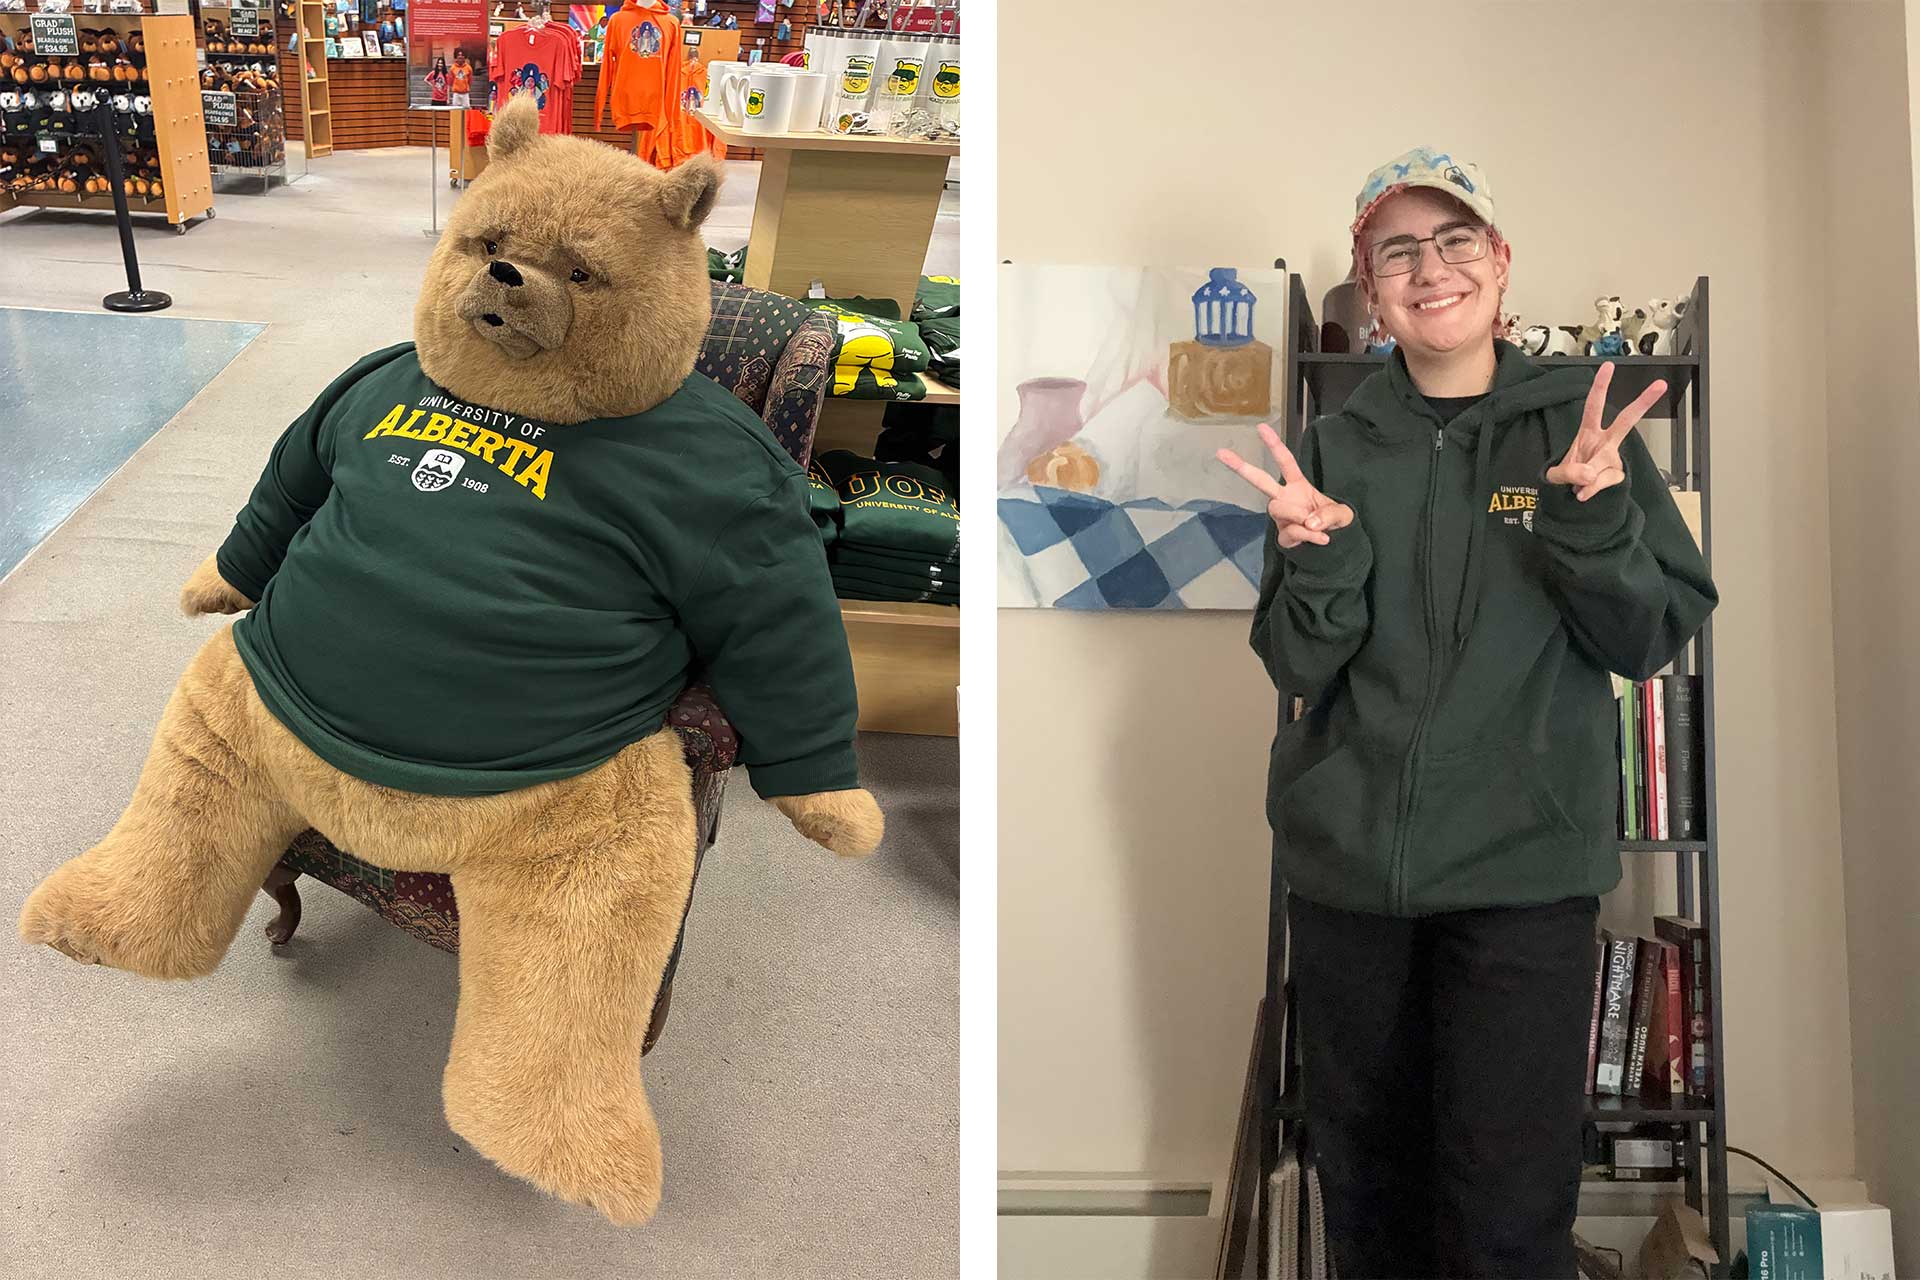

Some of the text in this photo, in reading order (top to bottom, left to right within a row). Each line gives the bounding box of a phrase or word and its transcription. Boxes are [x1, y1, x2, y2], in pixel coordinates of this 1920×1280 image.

[34, 19, 58, 28] GRAD
[47, 27, 74, 36] PLUSH
[44, 44, 69, 53] $34.95
[418, 395, 546, 440] UNIVERSITY OF
[362, 403, 555, 501] ALBERTA
[387, 453, 489, 494] EST. 1908
[1488, 492, 1539, 513] ALBE
[1500, 485, 1538, 495] UNIVERSI
[856, 501, 960, 521] UNIVERSITY OF ALB
[1624, 942, 1634, 980] FORGING A
[1607, 940, 1627, 1020] NIGHTMARE
[1633, 1026, 1648, 1089] EVELYN HUGO
[1760, 1250, 1769, 1280] 16 Pro
